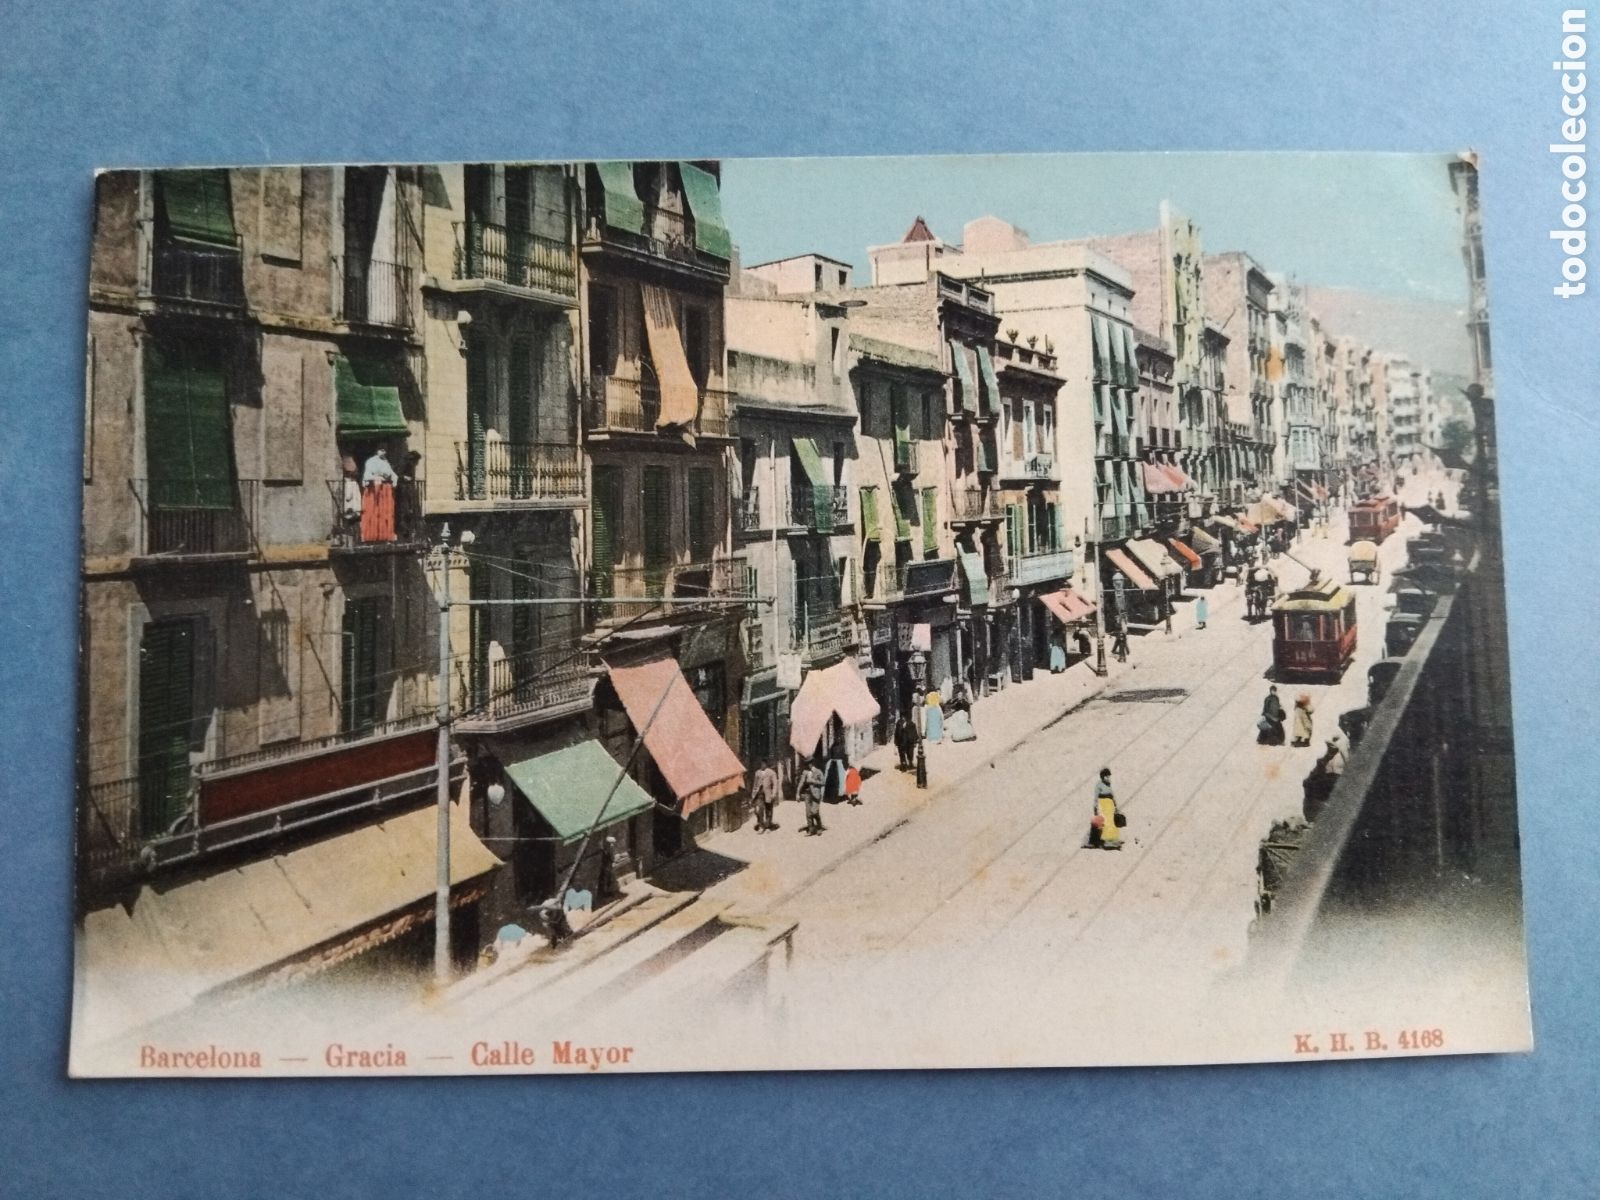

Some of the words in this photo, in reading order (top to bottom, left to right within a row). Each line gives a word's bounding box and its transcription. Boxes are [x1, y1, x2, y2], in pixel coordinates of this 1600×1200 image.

[1294, 1034, 1320, 1053] K.
[1330, 1032, 1355, 1052] H.
[1365, 1031, 1388, 1050] B.
[1398, 1029, 1444, 1049] 4168
[140, 1044, 262, 1069] Barcelona
[325, 1043, 407, 1068] Gracia
[471, 1041, 535, 1066] Calle
[552, 1040, 634, 1071] Mayor
